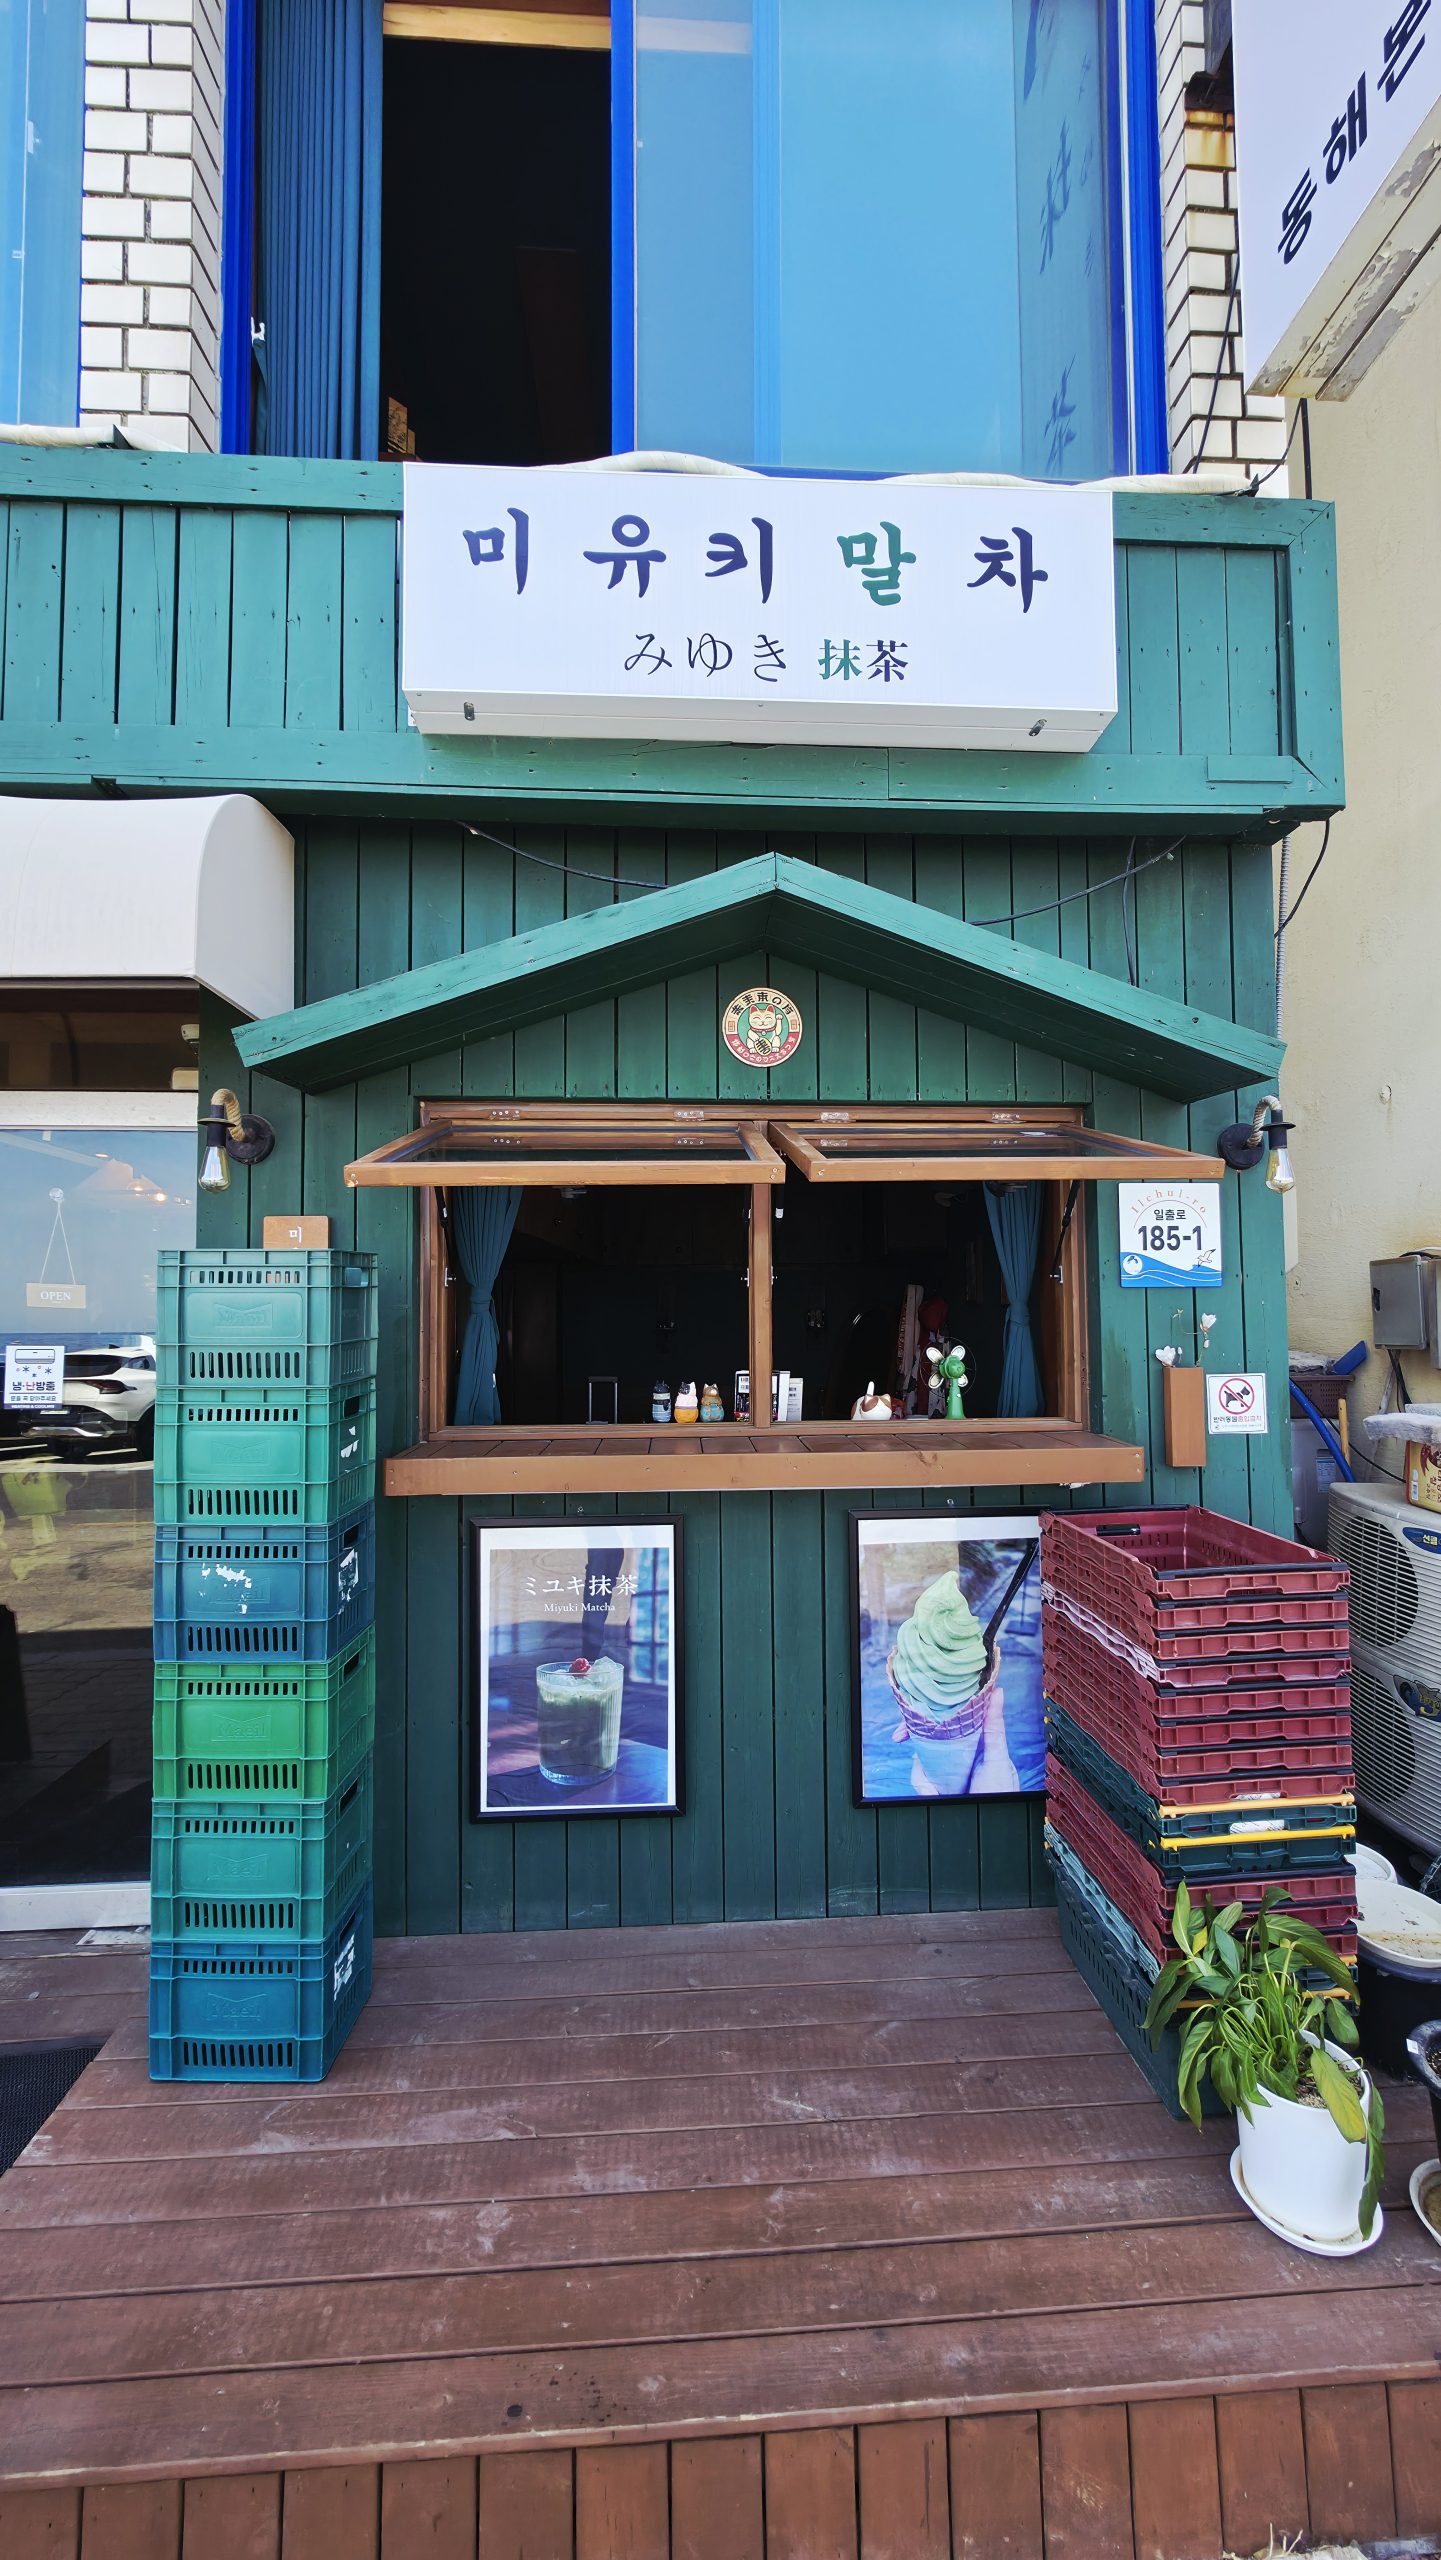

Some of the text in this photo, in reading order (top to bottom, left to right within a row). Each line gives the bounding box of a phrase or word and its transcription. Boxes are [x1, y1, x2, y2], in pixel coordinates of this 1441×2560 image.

[462, 507, 1049, 613] 미유키 말차
[624, 633, 909, 683] みゆき 抹茶
[1153, 1208, 1187, 1221] 일출로
[1138, 1225, 1203, 1251] 185-1
[40, 1291, 71, 1301] OPEN
[524, 1575, 638, 1596] ミユキ抹茶
[544, 1602, 616, 1614] Miyuki Matcha
